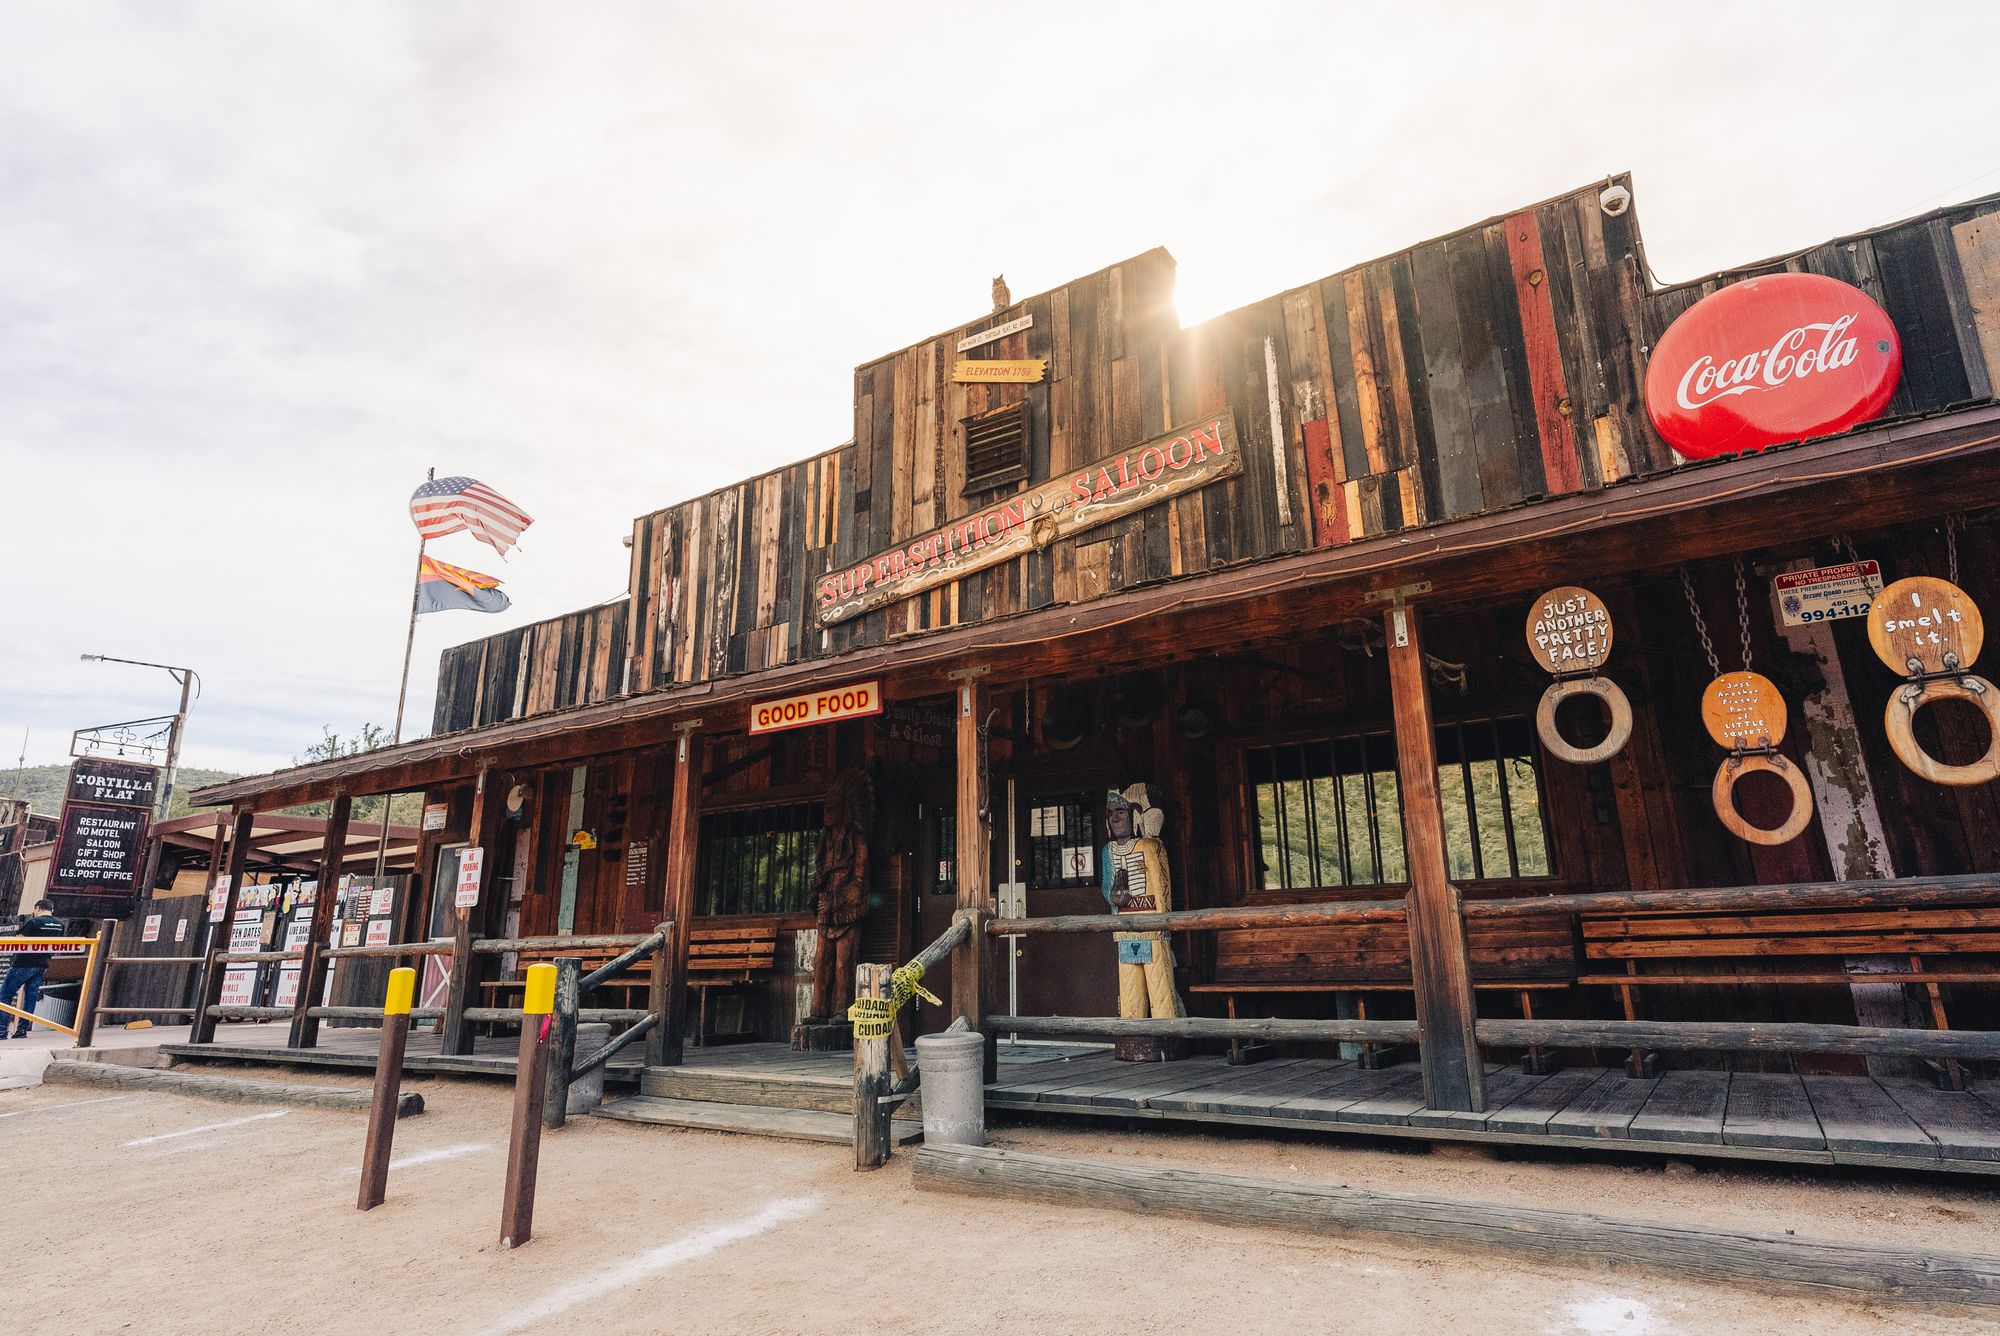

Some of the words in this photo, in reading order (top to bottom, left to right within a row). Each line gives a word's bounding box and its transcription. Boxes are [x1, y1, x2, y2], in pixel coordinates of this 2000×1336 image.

[1676, 311, 1859, 410] Coca-Cola
[966, 367, 1010, 376] ELEVATION
[1012, 367, 1032, 376] 1759
[821, 499, 1030, 609] SUPERSTITION
[1069, 420, 1225, 511] SALOON
[1783, 570, 1820, 582] PRIVATE
[1820, 562, 1870, 576] PROPERY
[1807, 571, 1859, 585] TRESPASSING
[1780, 588, 1799, 596] THESE
[1800, 583, 1832, 592] PREMISES
[1911, 592, 1921, 608] I
[1544, 596, 1587, 618] JUST
[1534, 610, 1606, 634] ANOTHER
[1884, 608, 1961, 632] smelt
[1536, 624, 1608, 650] PRETTY
[1915, 631, 1948, 646] it.
[1548, 638, 1608, 662] FACE!
[1718, 689, 1760, 698] Another
[758, 702, 810, 726] GOOD
[816, 690, 870, 715] FOOD
[1725, 720, 1764, 729] LITTLE
[1724, 728, 1769, 738] SQUIRTS
[76, 774, 153, 792] TORTILLA
[94, 787, 135, 800] FLAT
[80, 817, 136, 830] RESTAURANT
[76, 826, 90, 836] NO
[90, 828, 120, 838] MOTEL
[86, 838, 121, 848] SALOON
[78, 848, 98, 858] GIFT
[102, 850, 126, 860] SHOP
[75, 858, 122, 869] GROCERIES
[462, 862, 478, 871] PARKING
[102, 871, 134, 880] OFFICE
[458, 882, 478, 892] LOITERING
[243, 926, 262, 938] DATES
[240, 939, 258, 948] SUNDAYS
[855, 998, 890, 1011] UIDADO
